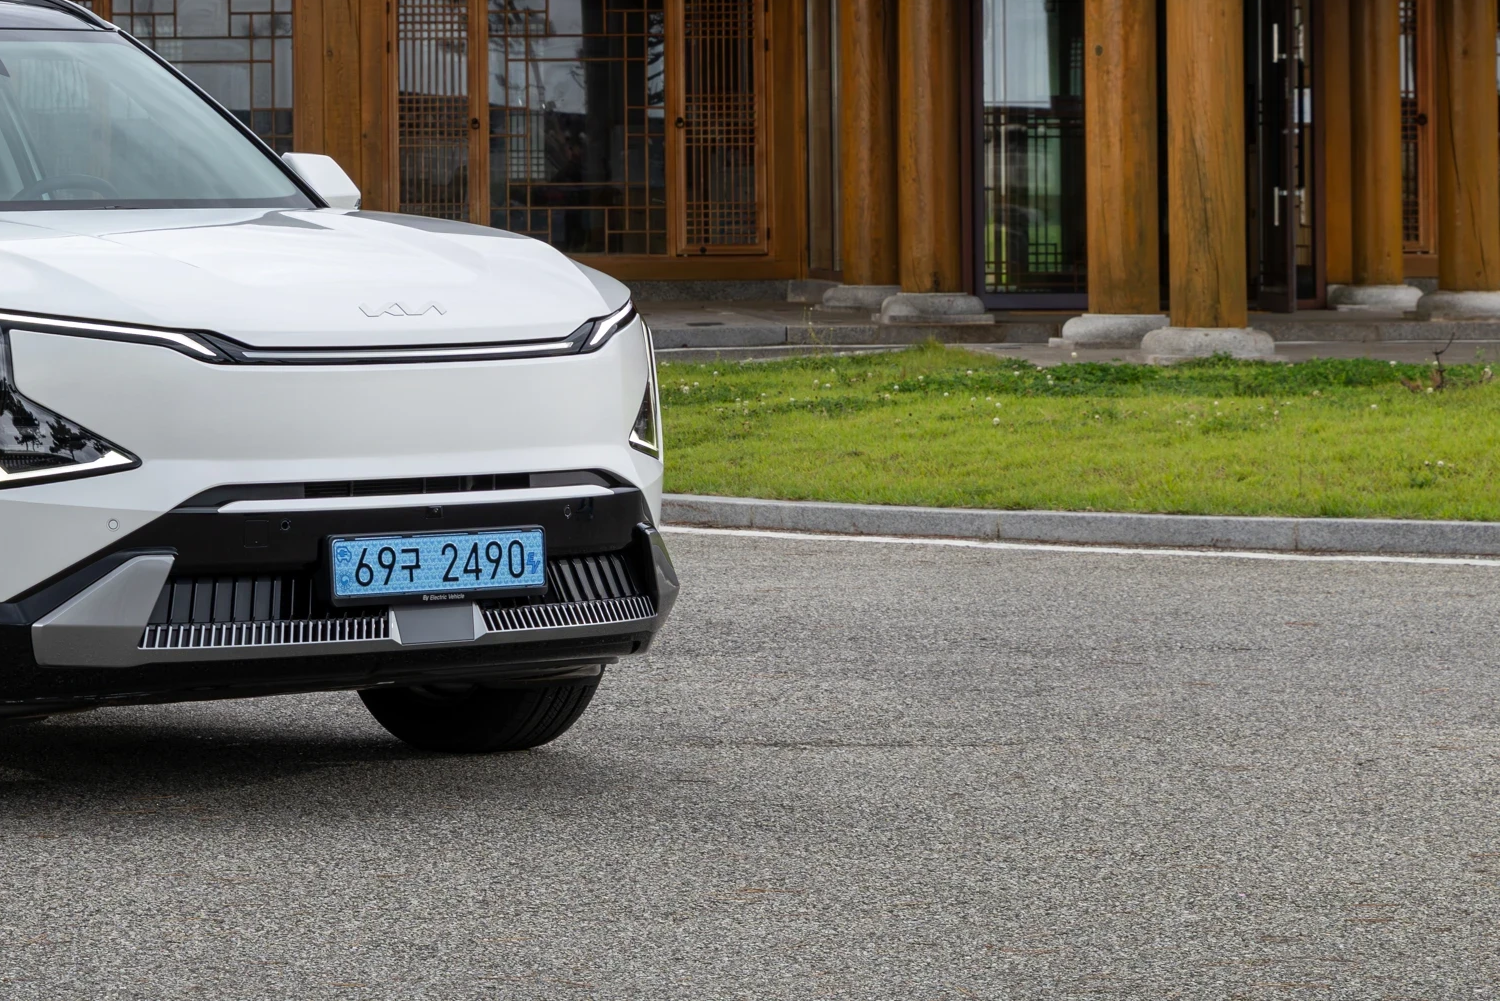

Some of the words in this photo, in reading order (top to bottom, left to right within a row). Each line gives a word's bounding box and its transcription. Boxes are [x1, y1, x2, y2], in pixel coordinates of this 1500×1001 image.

[355, 546, 421, 587] 69구
[441, 539, 525, 582] 2490
[430, 593, 447, 601] Electric
[448, 592, 465, 600] Vehicle
